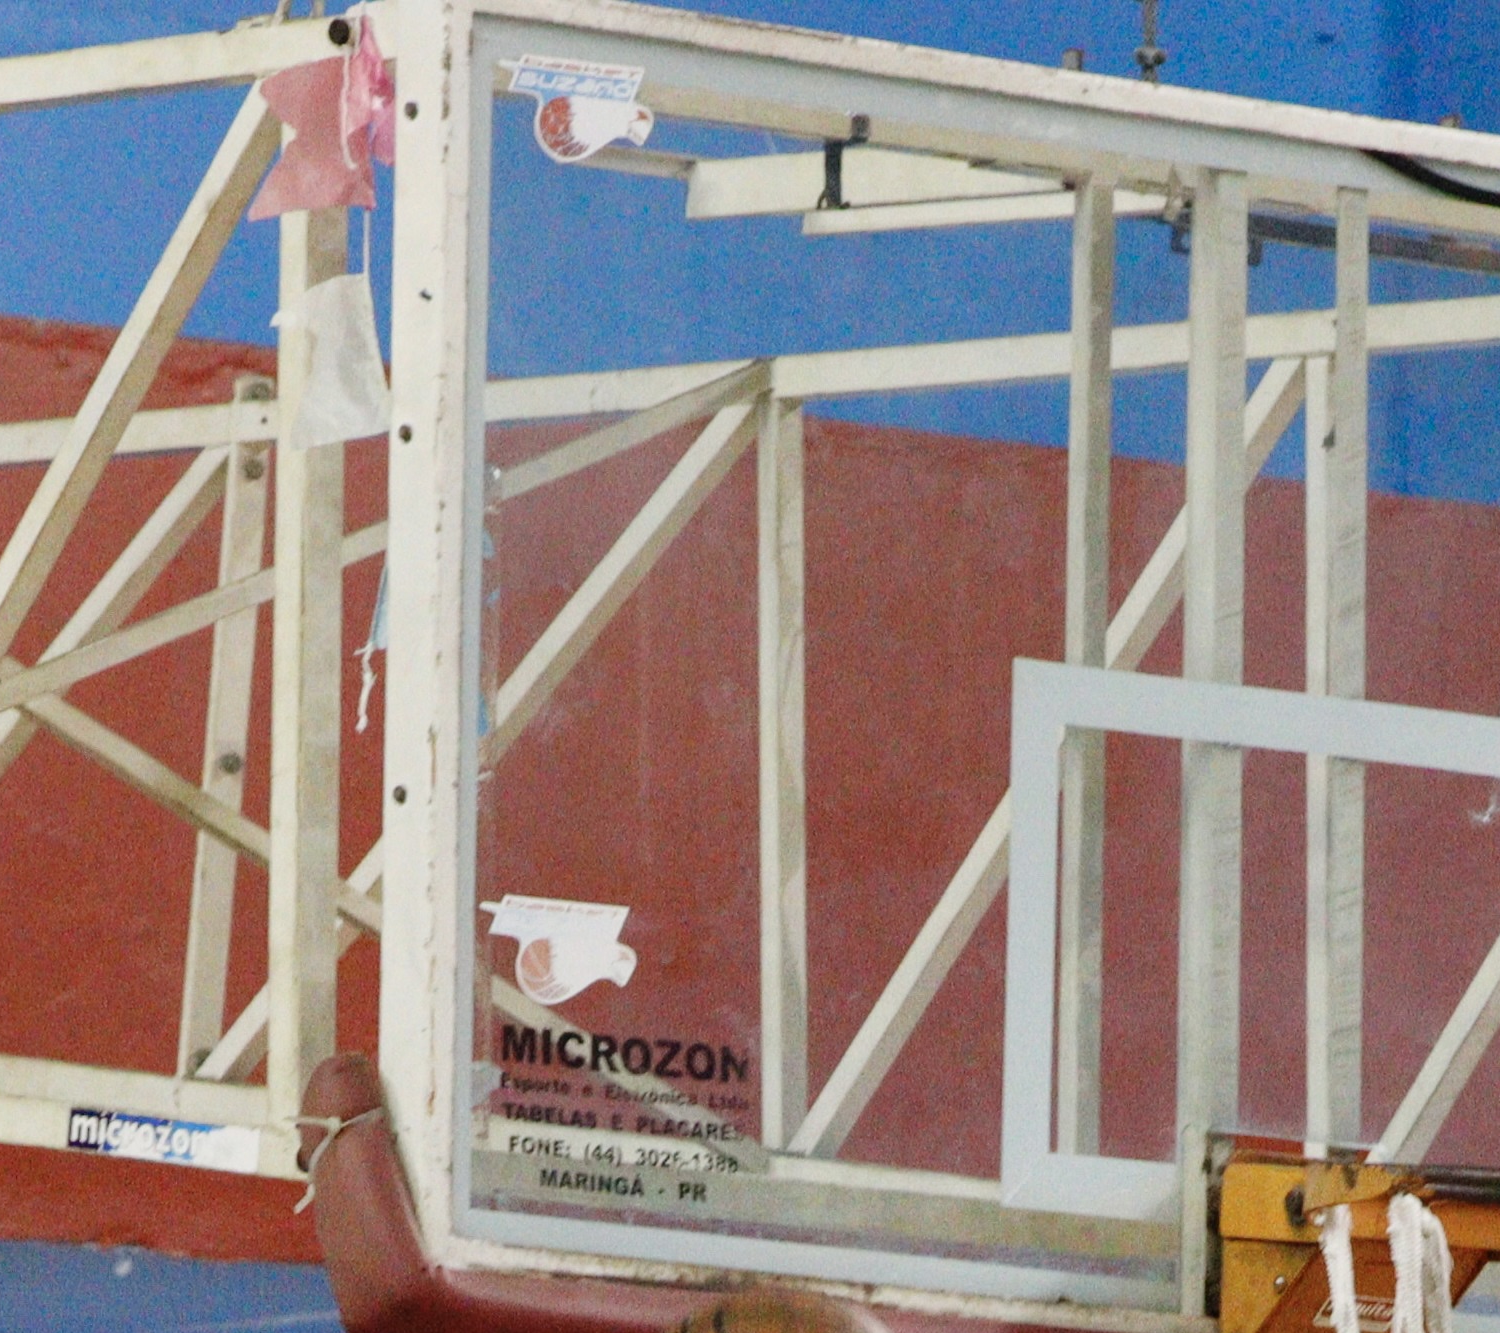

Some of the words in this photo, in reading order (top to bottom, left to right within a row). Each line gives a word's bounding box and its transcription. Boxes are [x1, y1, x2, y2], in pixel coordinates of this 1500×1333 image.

[501, 1024, 748, 1083] MICROZON
[502, 1101, 597, 1130] TABELAS
[611, 1111, 623, 1131] E
[508, 1135, 572, 1158] FONE:
[584, 1143, 623, 1167] (44)
[540, 1168, 645, 1197] MARINGÁ
[678, 1181, 707, 1201] PR
